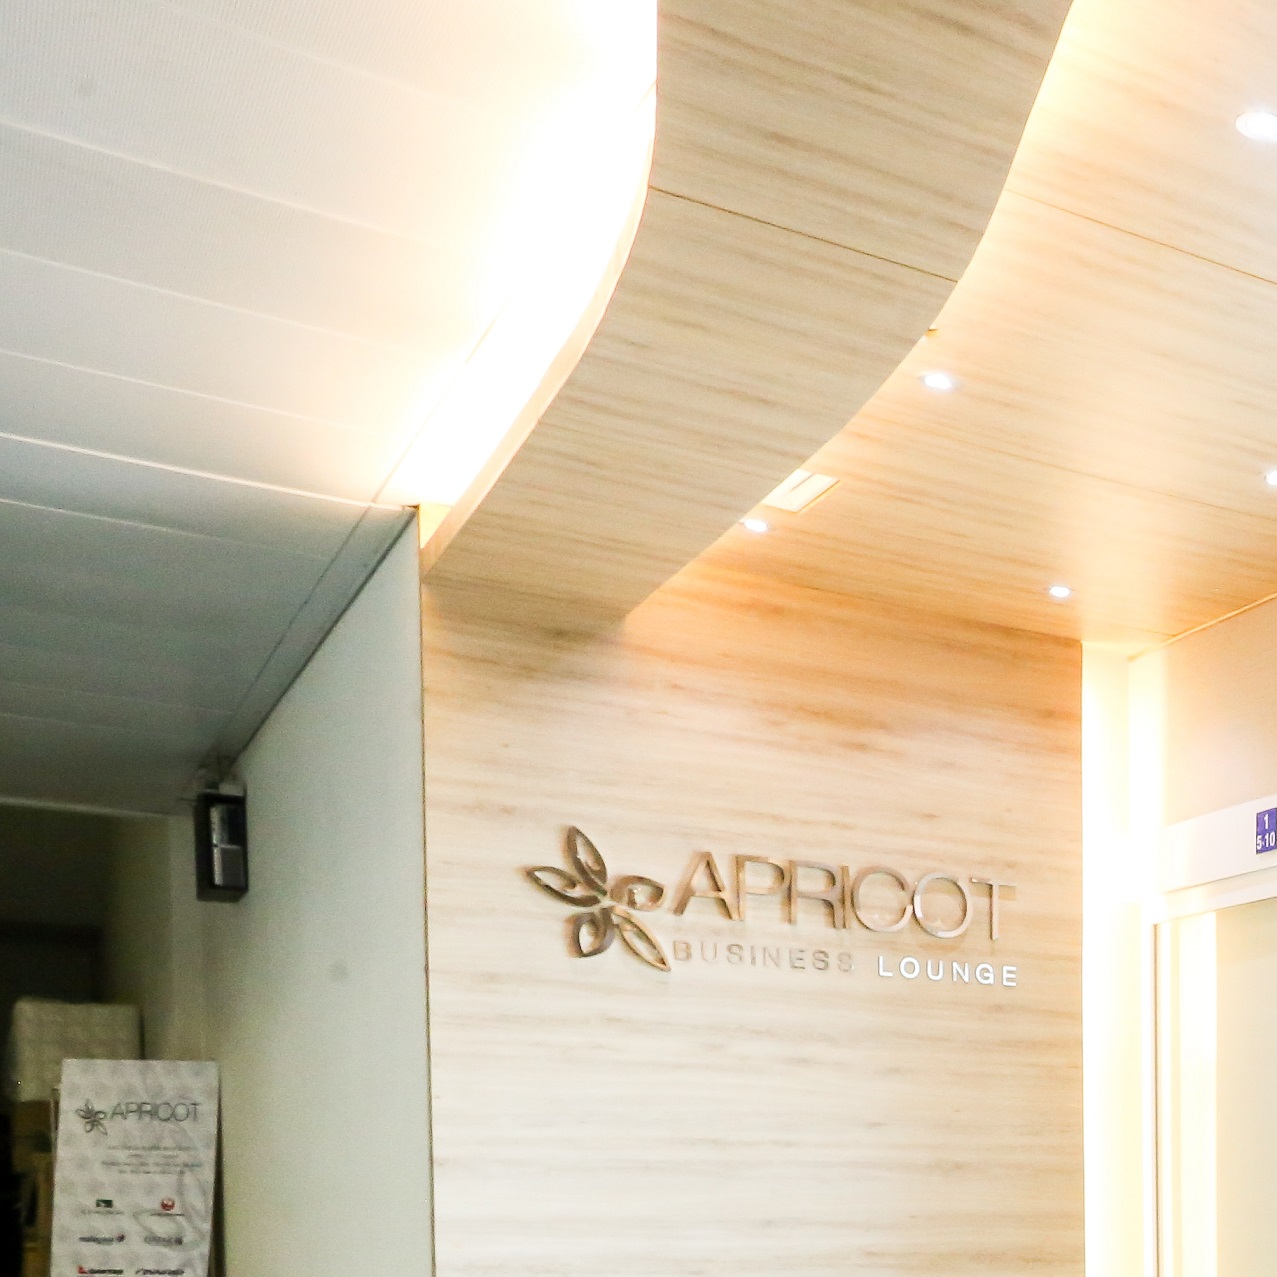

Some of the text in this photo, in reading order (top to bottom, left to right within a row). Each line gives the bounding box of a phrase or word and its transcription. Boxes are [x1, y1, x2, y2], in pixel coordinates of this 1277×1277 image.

[1264, 814, 1269, 829] 1
[672, 850, 1018, 941] APRICOT
[672, 939, 1019, 987] BUSINESS LOUNGE
[109, 1101, 202, 1123] APRICOT
